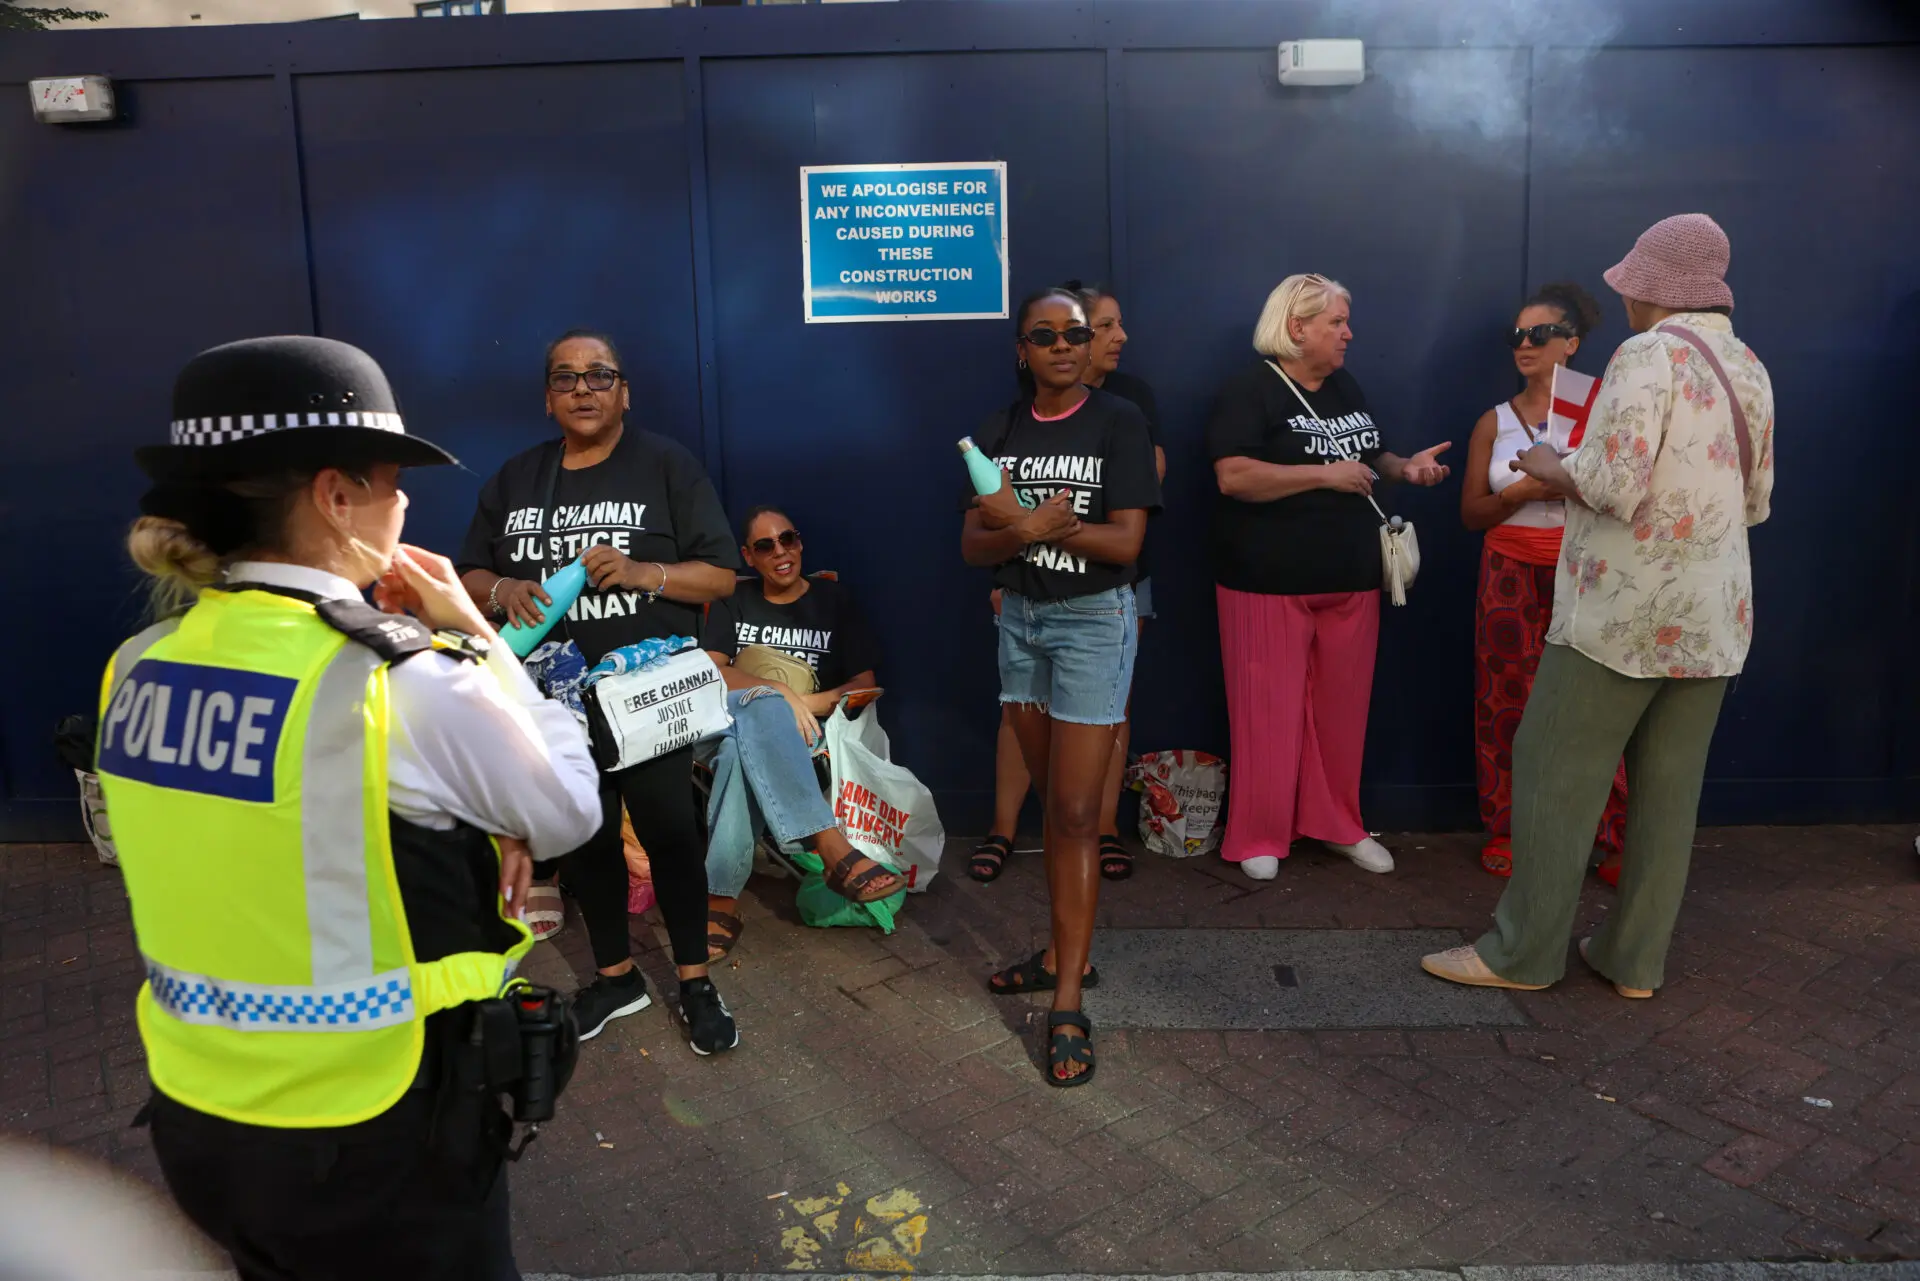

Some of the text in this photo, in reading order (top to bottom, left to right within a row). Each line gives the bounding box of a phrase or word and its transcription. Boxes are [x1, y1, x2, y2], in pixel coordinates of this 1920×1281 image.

[821, 181, 987, 197] WE APOLOGISE FOR
[815, 203, 995, 219] ANY INCONVENIENCE
[836, 224, 975, 240] CAUSED DURING
[878, 247, 933, 261] THESE
[839, 268, 973, 283] CONSTRUCTION
[875, 290, 937, 303] WORKS
[1020, 455, 1103, 483] CHANNAY
[552, 501, 646, 529] CHANNAY
[761, 625, 832, 649] CHANNAY
[624, 669, 714, 714] FREE CHANNAY
[657, 697, 694, 724] JUSTICE
[103, 678, 275, 777] POLICE
[668, 717, 688, 737] FOR
[1195, 787, 1217, 802] bag
[879, 799, 910, 831] DAY
